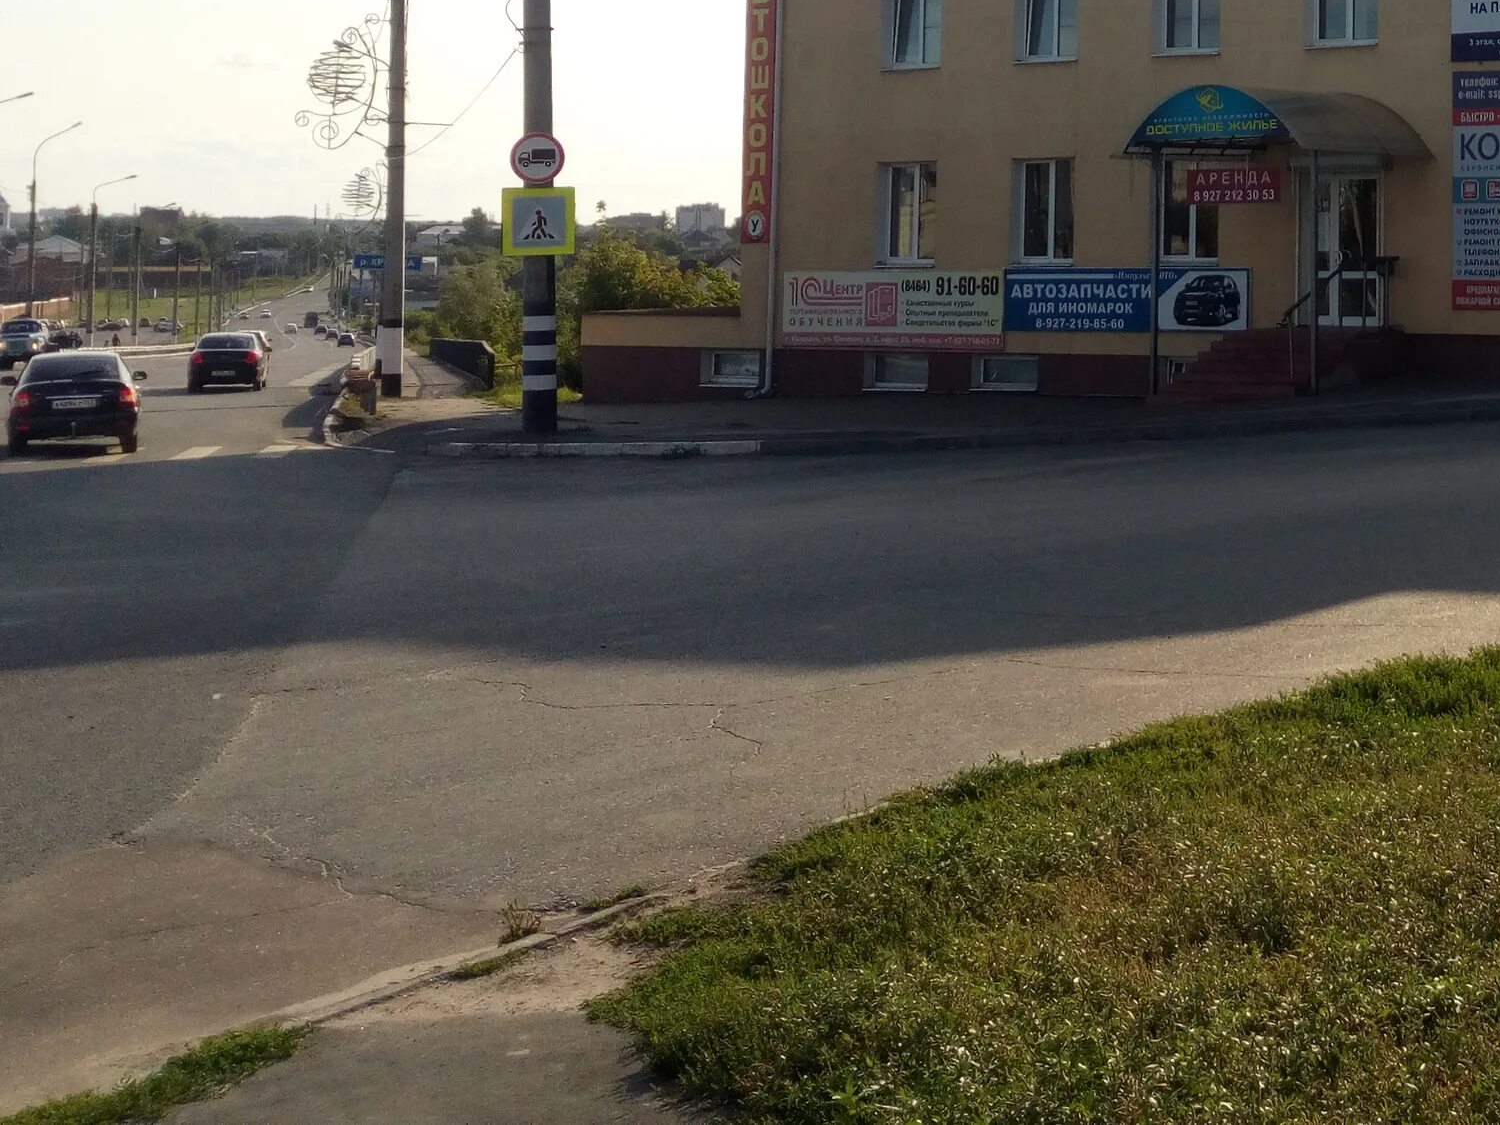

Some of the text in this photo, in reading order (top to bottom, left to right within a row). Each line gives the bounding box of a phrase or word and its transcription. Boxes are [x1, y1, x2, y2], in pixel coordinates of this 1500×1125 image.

[1470, 1, 1487, 14] НА
[1460, 111, 1494, 123] БЫСТРО
[1146, 119, 1278, 135] ДОСТУПНОЕ ЖИЛЬЕ
[1196, 170, 1271, 186] АРЕНДА
[1194, 189, 1275, 201] 8 927 212 30 53
[901, 276, 999, 295] (8464) 91-60-60
[1011, 283, 1152, 299] АВТОЗАПЧАСТИ
[1028, 302, 1133, 315] ДЛЯ ИНОМАРОК
[789, 317, 863, 327] ОБУЧЕНИЯ
[1036, 318, 1125, 329] 8-927-219-85-60
